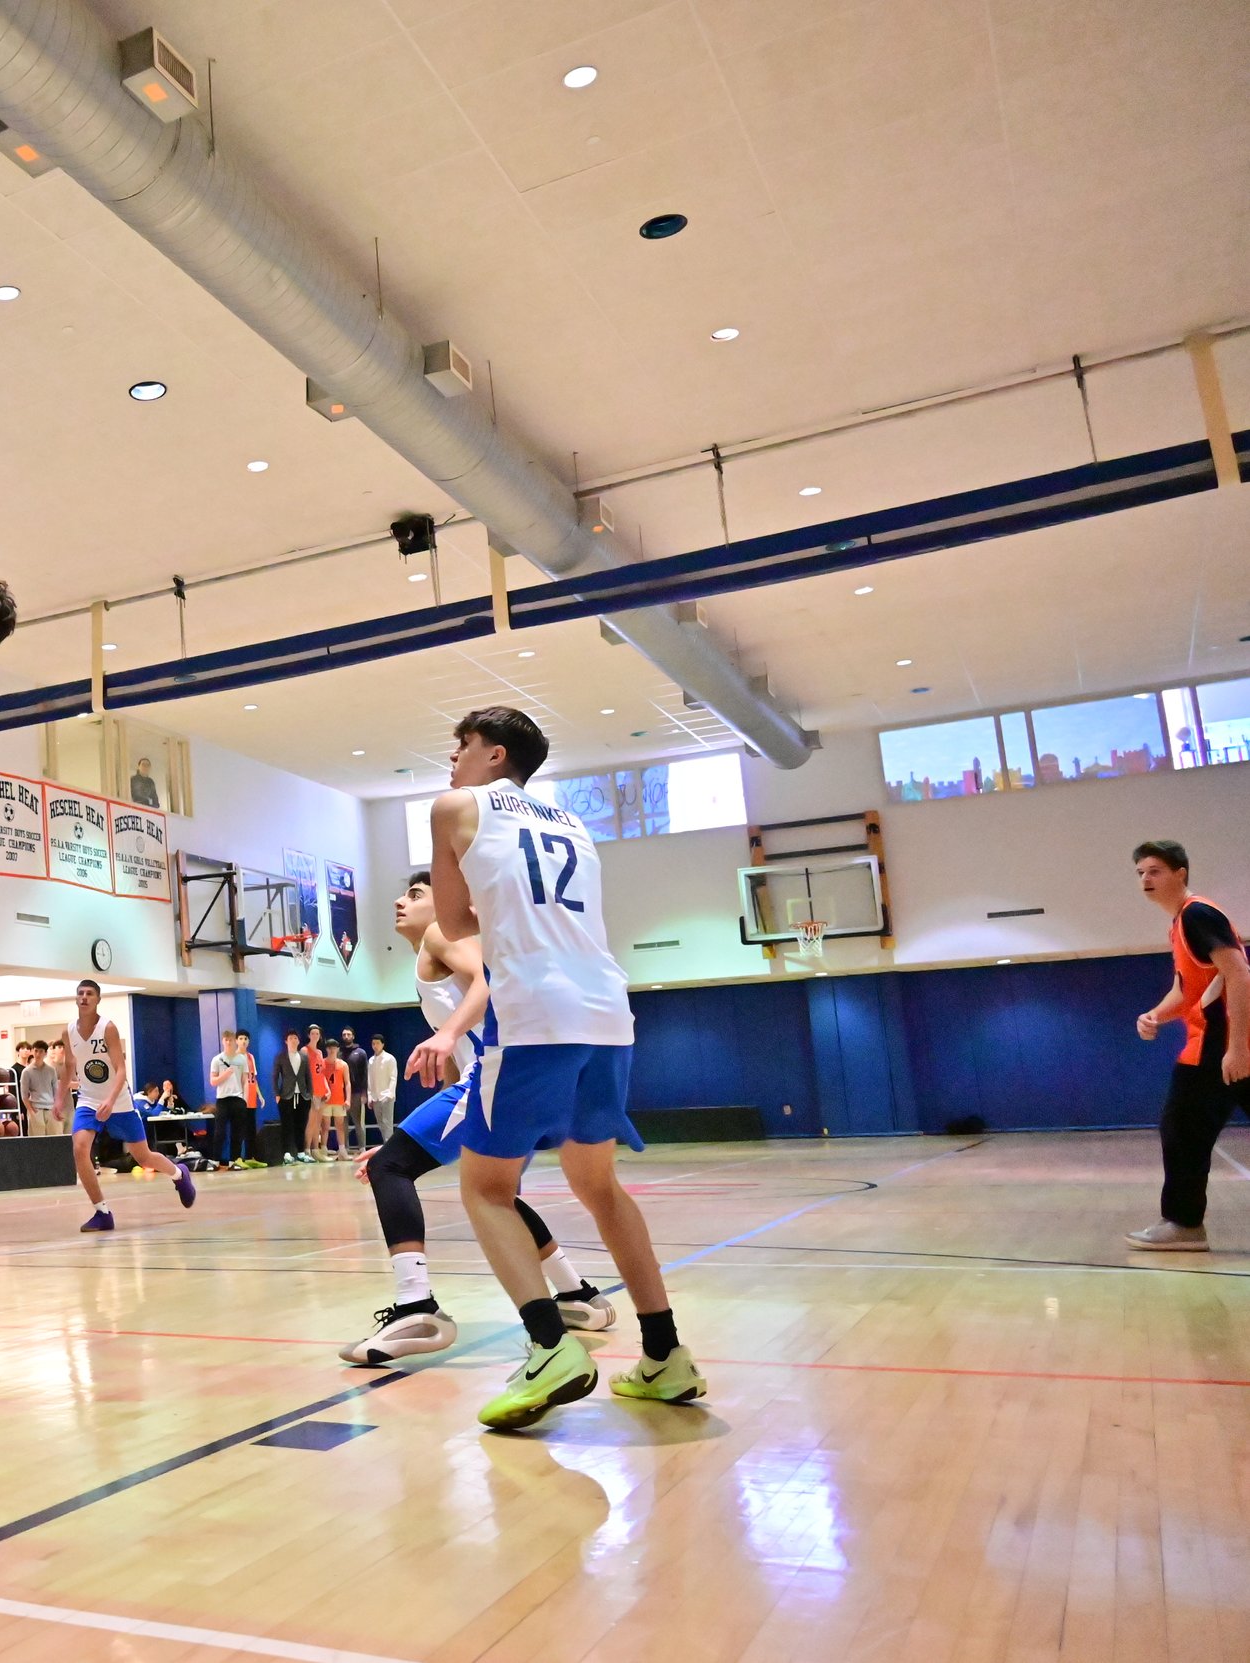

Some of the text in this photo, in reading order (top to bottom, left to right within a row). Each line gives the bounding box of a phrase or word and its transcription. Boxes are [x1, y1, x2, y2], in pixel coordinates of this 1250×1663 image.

[18, 784, 39, 815] HEAT
[487, 790, 577, 828] GURFINKEL
[50, 799, 104, 831] HESCHEL HEAT
[114, 815, 163, 844] HESCHEL HEAT
[8, 839, 36, 852] CHAMPIONS
[59, 852, 102, 869] LEAGUE CHAMPIONS
[518, 828, 585, 913] 12
[90, 1038, 108, 1055] 23
